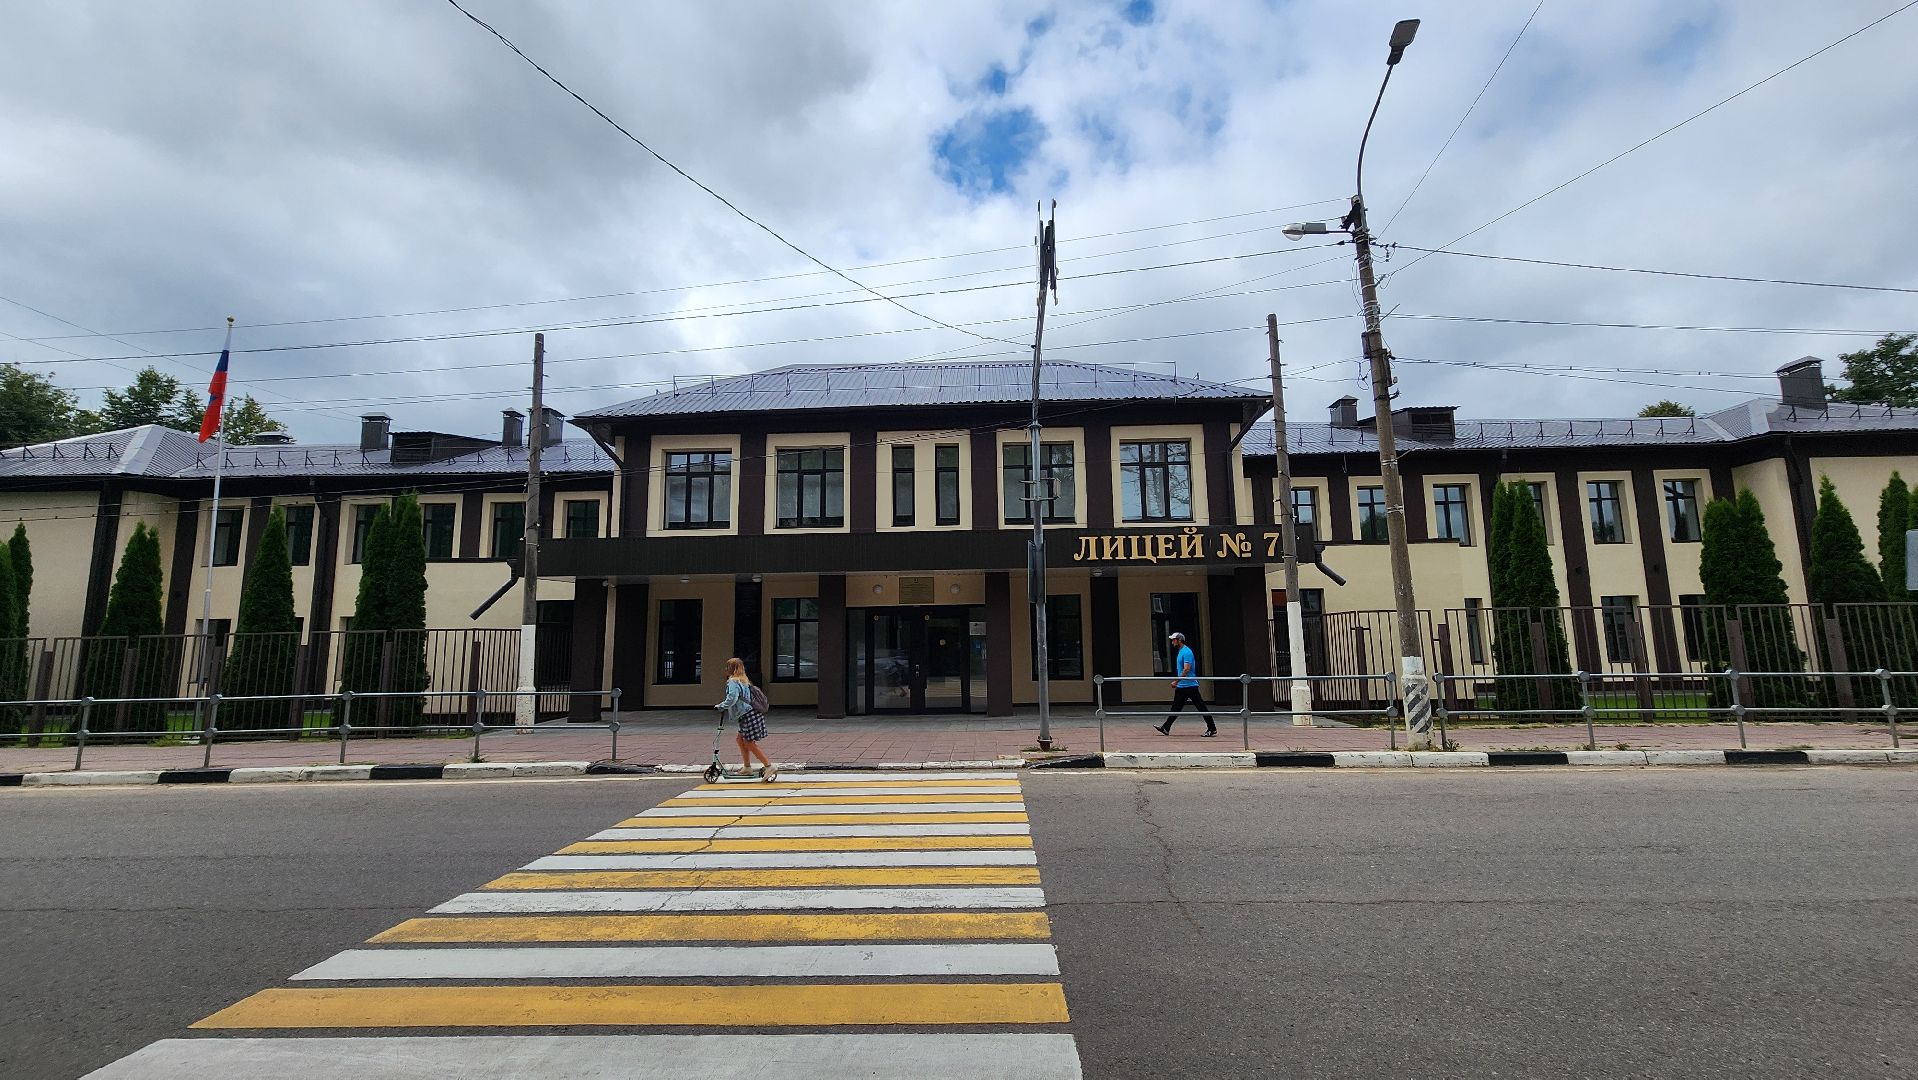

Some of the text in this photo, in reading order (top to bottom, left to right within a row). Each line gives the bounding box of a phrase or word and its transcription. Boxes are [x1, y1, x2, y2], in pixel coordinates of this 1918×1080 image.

[1073, 526, 1280, 564] ЛИЦЕЙ № 7
